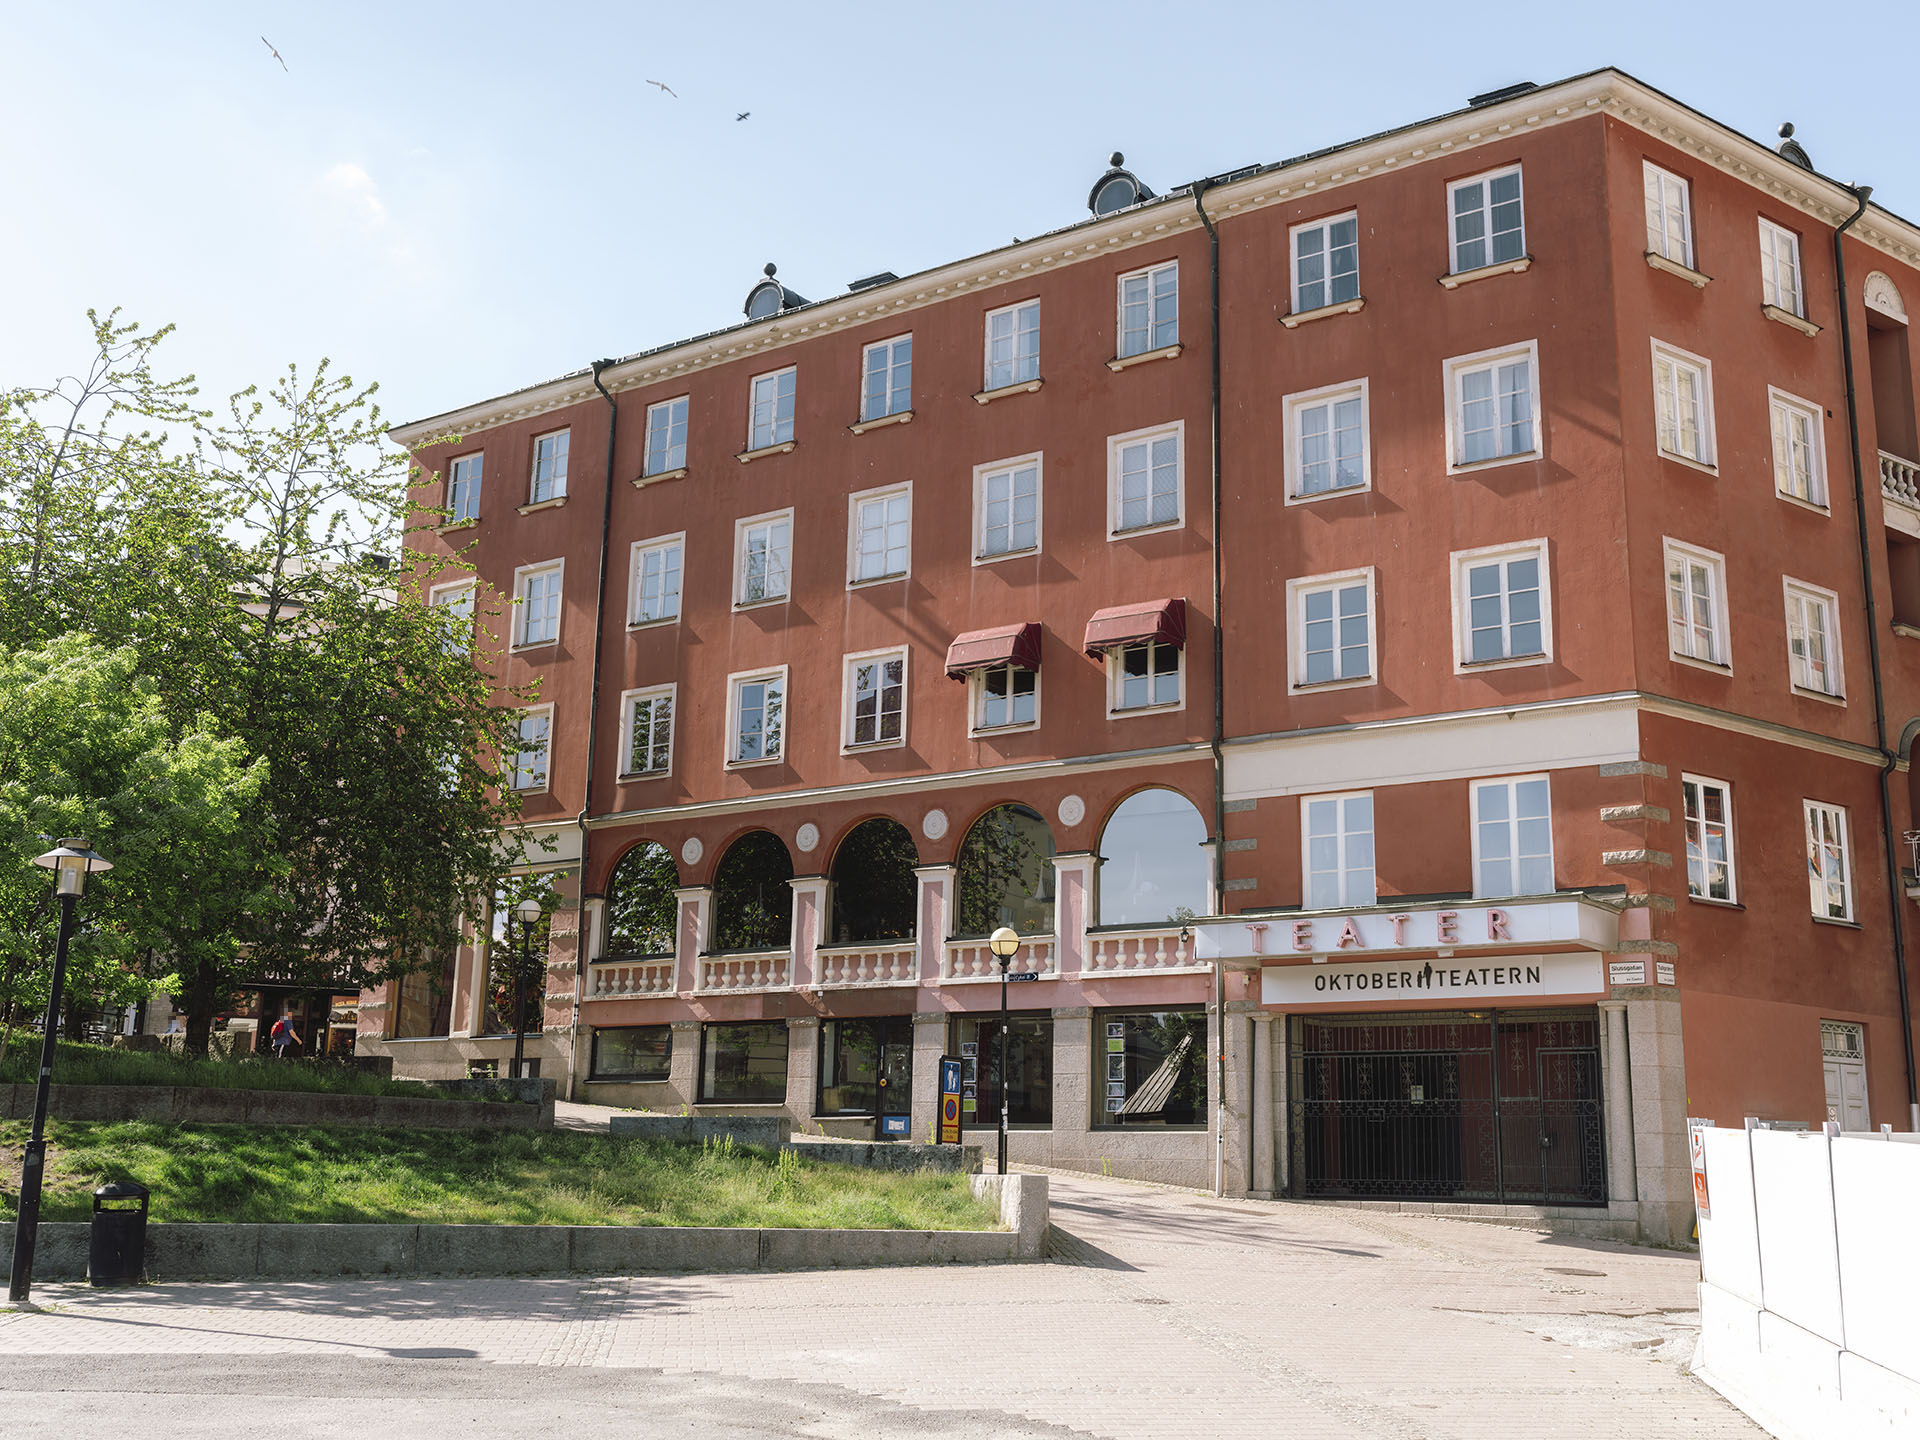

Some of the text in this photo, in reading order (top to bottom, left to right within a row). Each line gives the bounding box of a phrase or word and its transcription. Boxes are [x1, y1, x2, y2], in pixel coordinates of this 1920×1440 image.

[1245, 909, 1512, 954] TEATER
[1314, 966, 1541, 991] OKTOBER TEATERN
